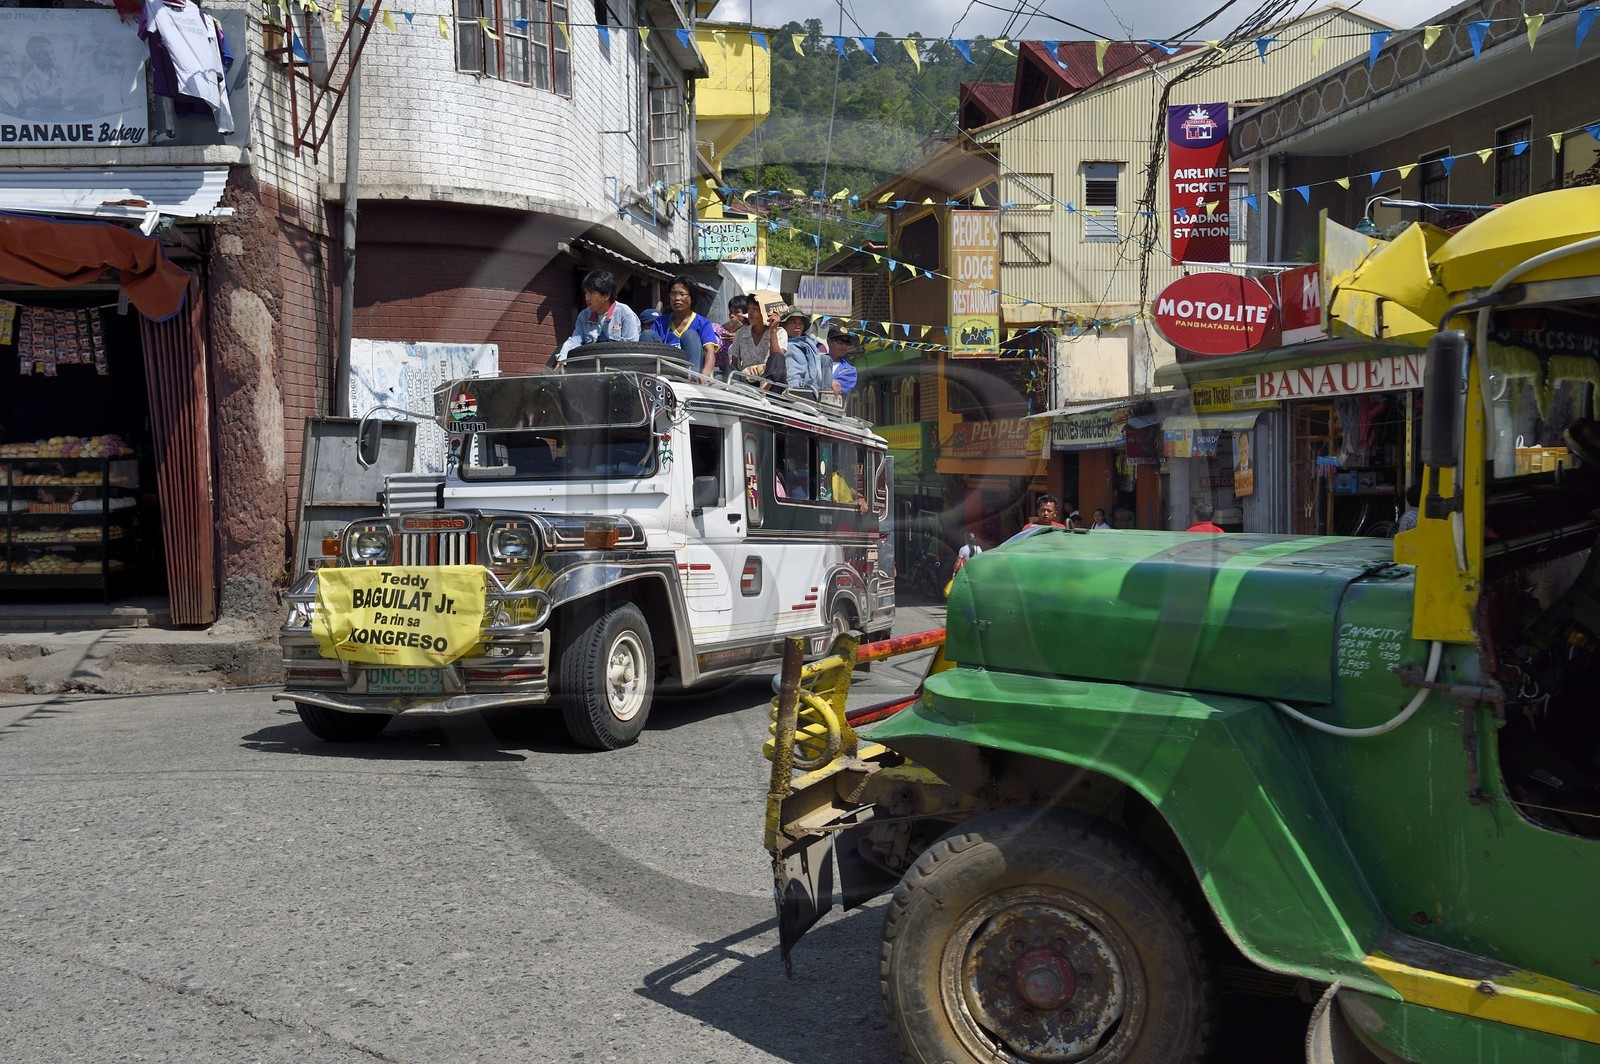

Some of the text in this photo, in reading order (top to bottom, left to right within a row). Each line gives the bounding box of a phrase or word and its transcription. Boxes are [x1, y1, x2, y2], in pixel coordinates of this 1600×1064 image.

[1, 122, 145, 143] BANAUE Bakery
[1174, 168, 1227, 180] AIRLINE
[1175, 182, 1226, 194] TICKET
[1196, 197, 1206, 207] &
[953, 214, 999, 246] PEOPLE'S
[1173, 227, 1229, 239] STATION
[710, 235, 741, 244] LODGE
[958, 256, 993, 280] LODGE
[968, 280, 982, 289] and
[953, 290, 998, 314] RESTAURANT
[1158, 298, 1268, 324] MOTOLITE
[1175, 320, 1254, 332] PANGMATAGALAN
[1259, 358, 1384, 398] BANAUE
[971, 419, 1026, 441] PEOPLE
[966, 442, 989, 450] LODGE
[1200, 477, 1234, 488] XEROX
[381, 572, 429, 590] Teddy
[353, 587, 457, 615] BAGUILAT Jr.
[374, 612, 420, 628] Pa rin sa
[348, 627, 448, 653] KONGRESO
